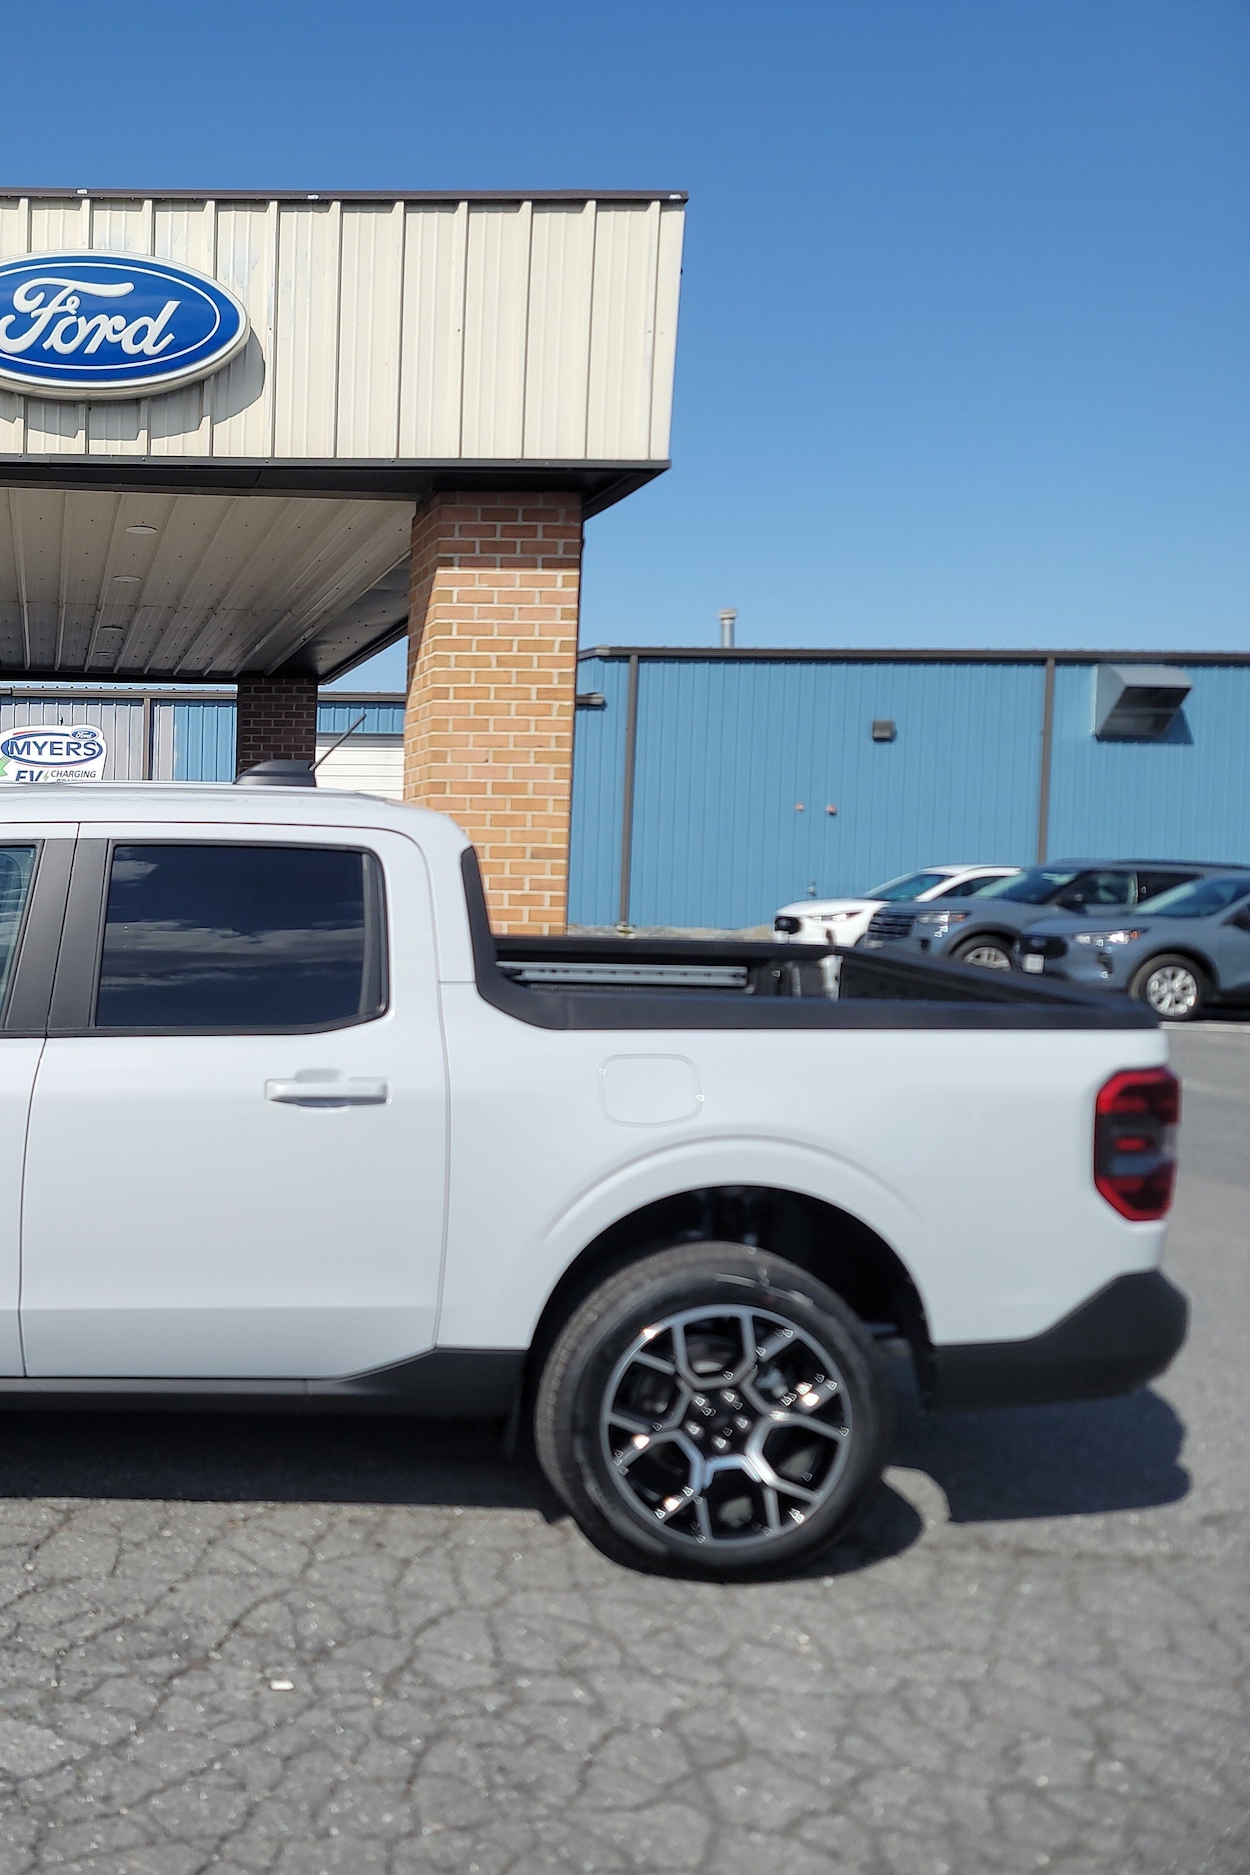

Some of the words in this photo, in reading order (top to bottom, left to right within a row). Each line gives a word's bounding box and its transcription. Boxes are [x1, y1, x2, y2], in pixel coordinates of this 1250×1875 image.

[9, 741, 97, 756] MYERS
[15, 770, 44, 782] EV
[50, 769, 97, 778] CHARGING
